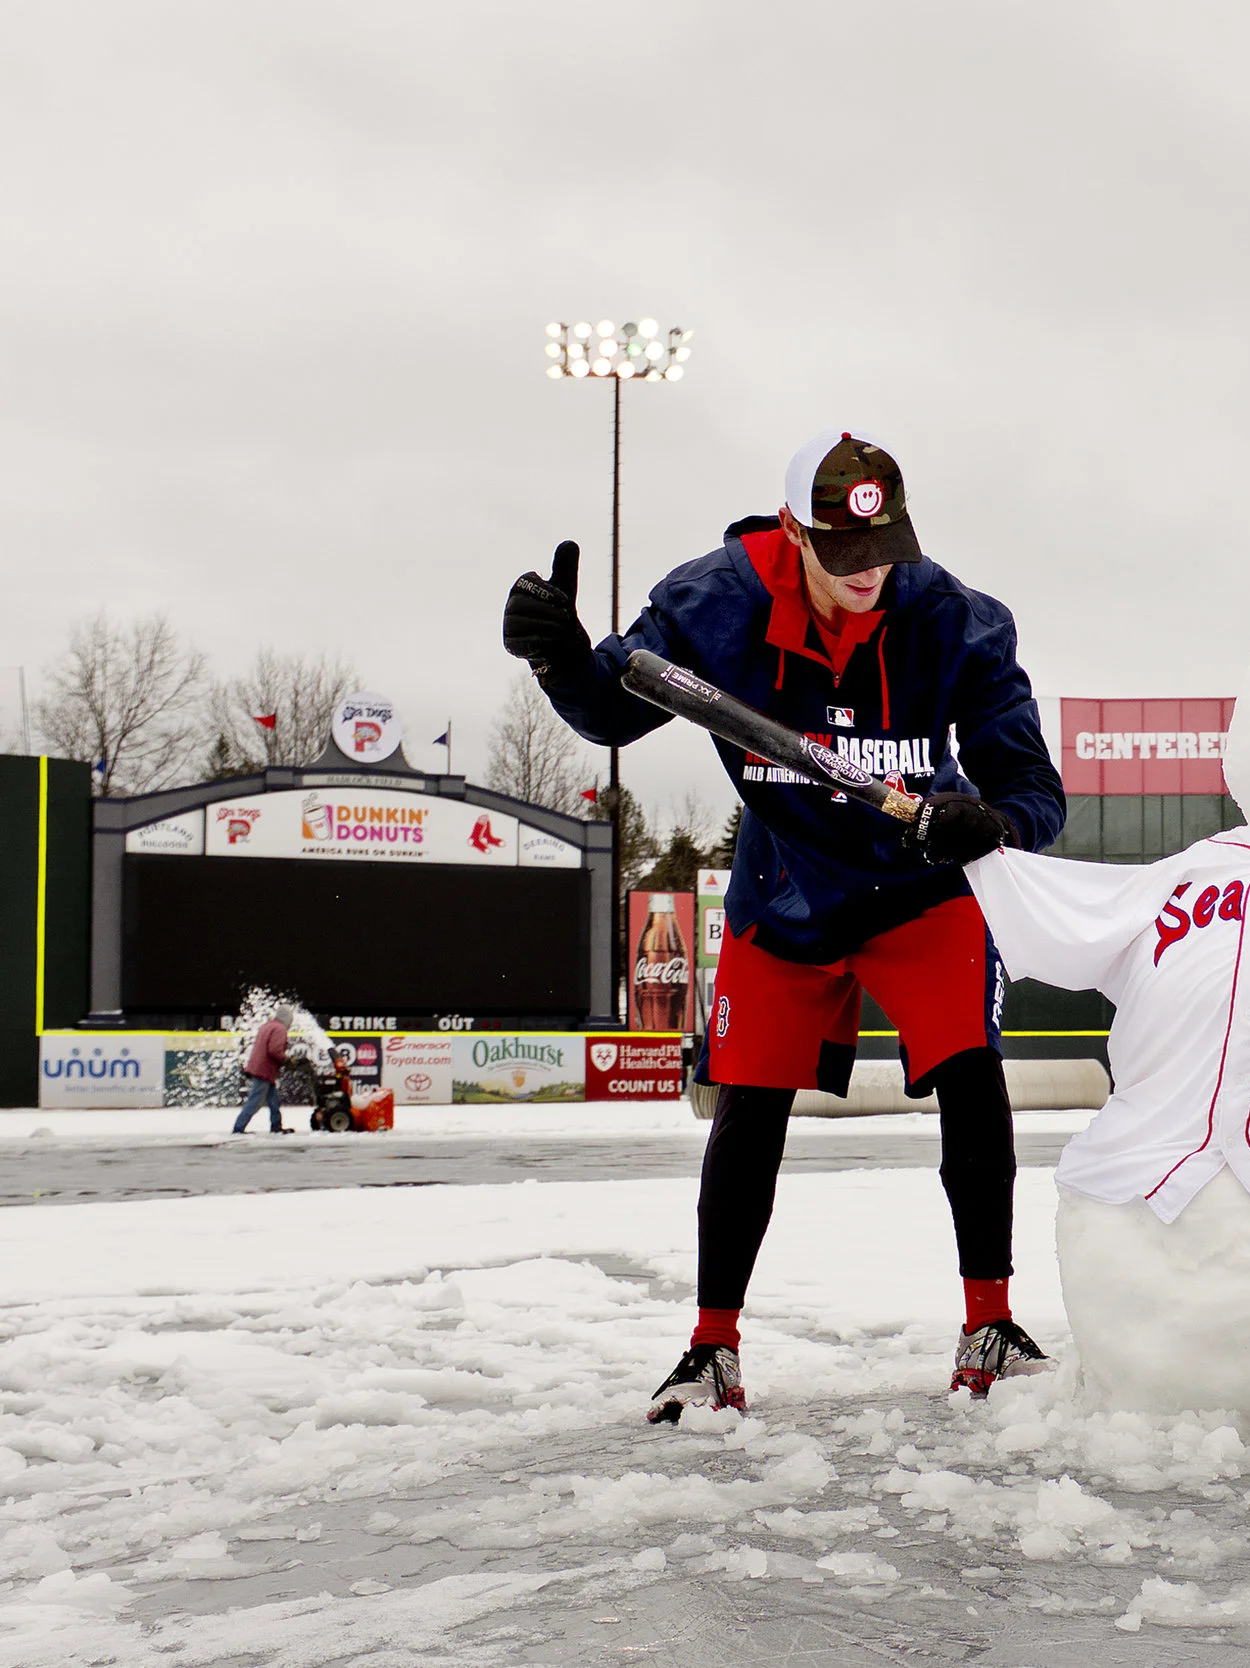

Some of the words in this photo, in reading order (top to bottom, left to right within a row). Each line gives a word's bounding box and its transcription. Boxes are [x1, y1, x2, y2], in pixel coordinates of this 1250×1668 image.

[517, 579, 551, 600] GORE-TEX
[671, 672, 699, 689] PRIME
[813, 747, 866, 782] Slugger
[837, 736, 934, 775] BASEBALL
[743, 765, 764, 782] MLB
[337, 806, 429, 825] DUNKIN'
[916, 803, 934, 840] GORE-TEX
[337, 824, 424, 844] DONUTS
[1154, 880, 1244, 968] Sea
[330, 1017, 397, 1030] STRIKE
[438, 1018, 474, 1031] OUT
[386, 1036, 452, 1051] Emerson
[472, 1037, 564, 1067] Oakhurst
[620, 1045, 665, 1057] Harvard
[44, 1048, 140, 1078] unum
[386, 1055, 451, 1068] Toyota.com
[620, 1057, 682, 1069] HealthCare
[608, 1080, 655, 1093] COUNT
[657, 1080, 675, 1093] US
